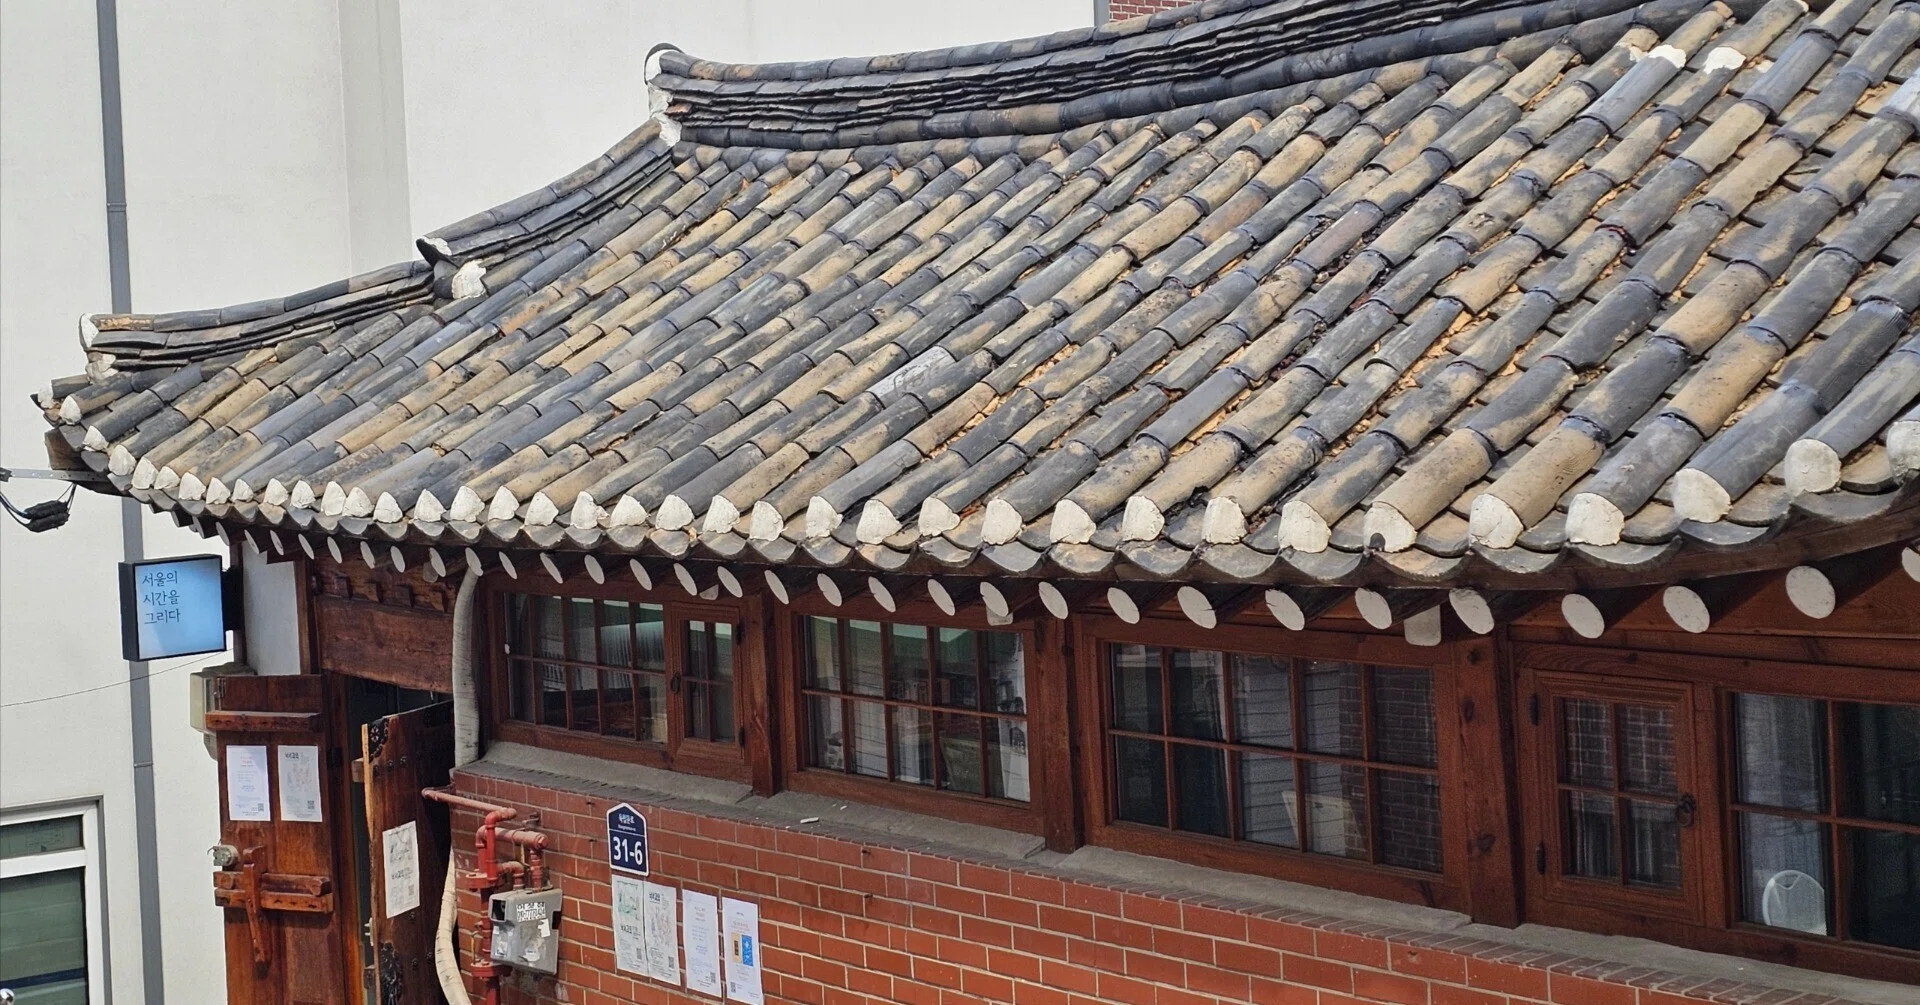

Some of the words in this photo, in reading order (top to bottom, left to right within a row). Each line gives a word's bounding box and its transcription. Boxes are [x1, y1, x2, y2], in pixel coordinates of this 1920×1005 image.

[142, 570, 178, 587] 서울의
[143, 589, 181, 606] 시간을
[144, 608, 181, 624] 그리다
[613, 836, 643, 866] 31-6
